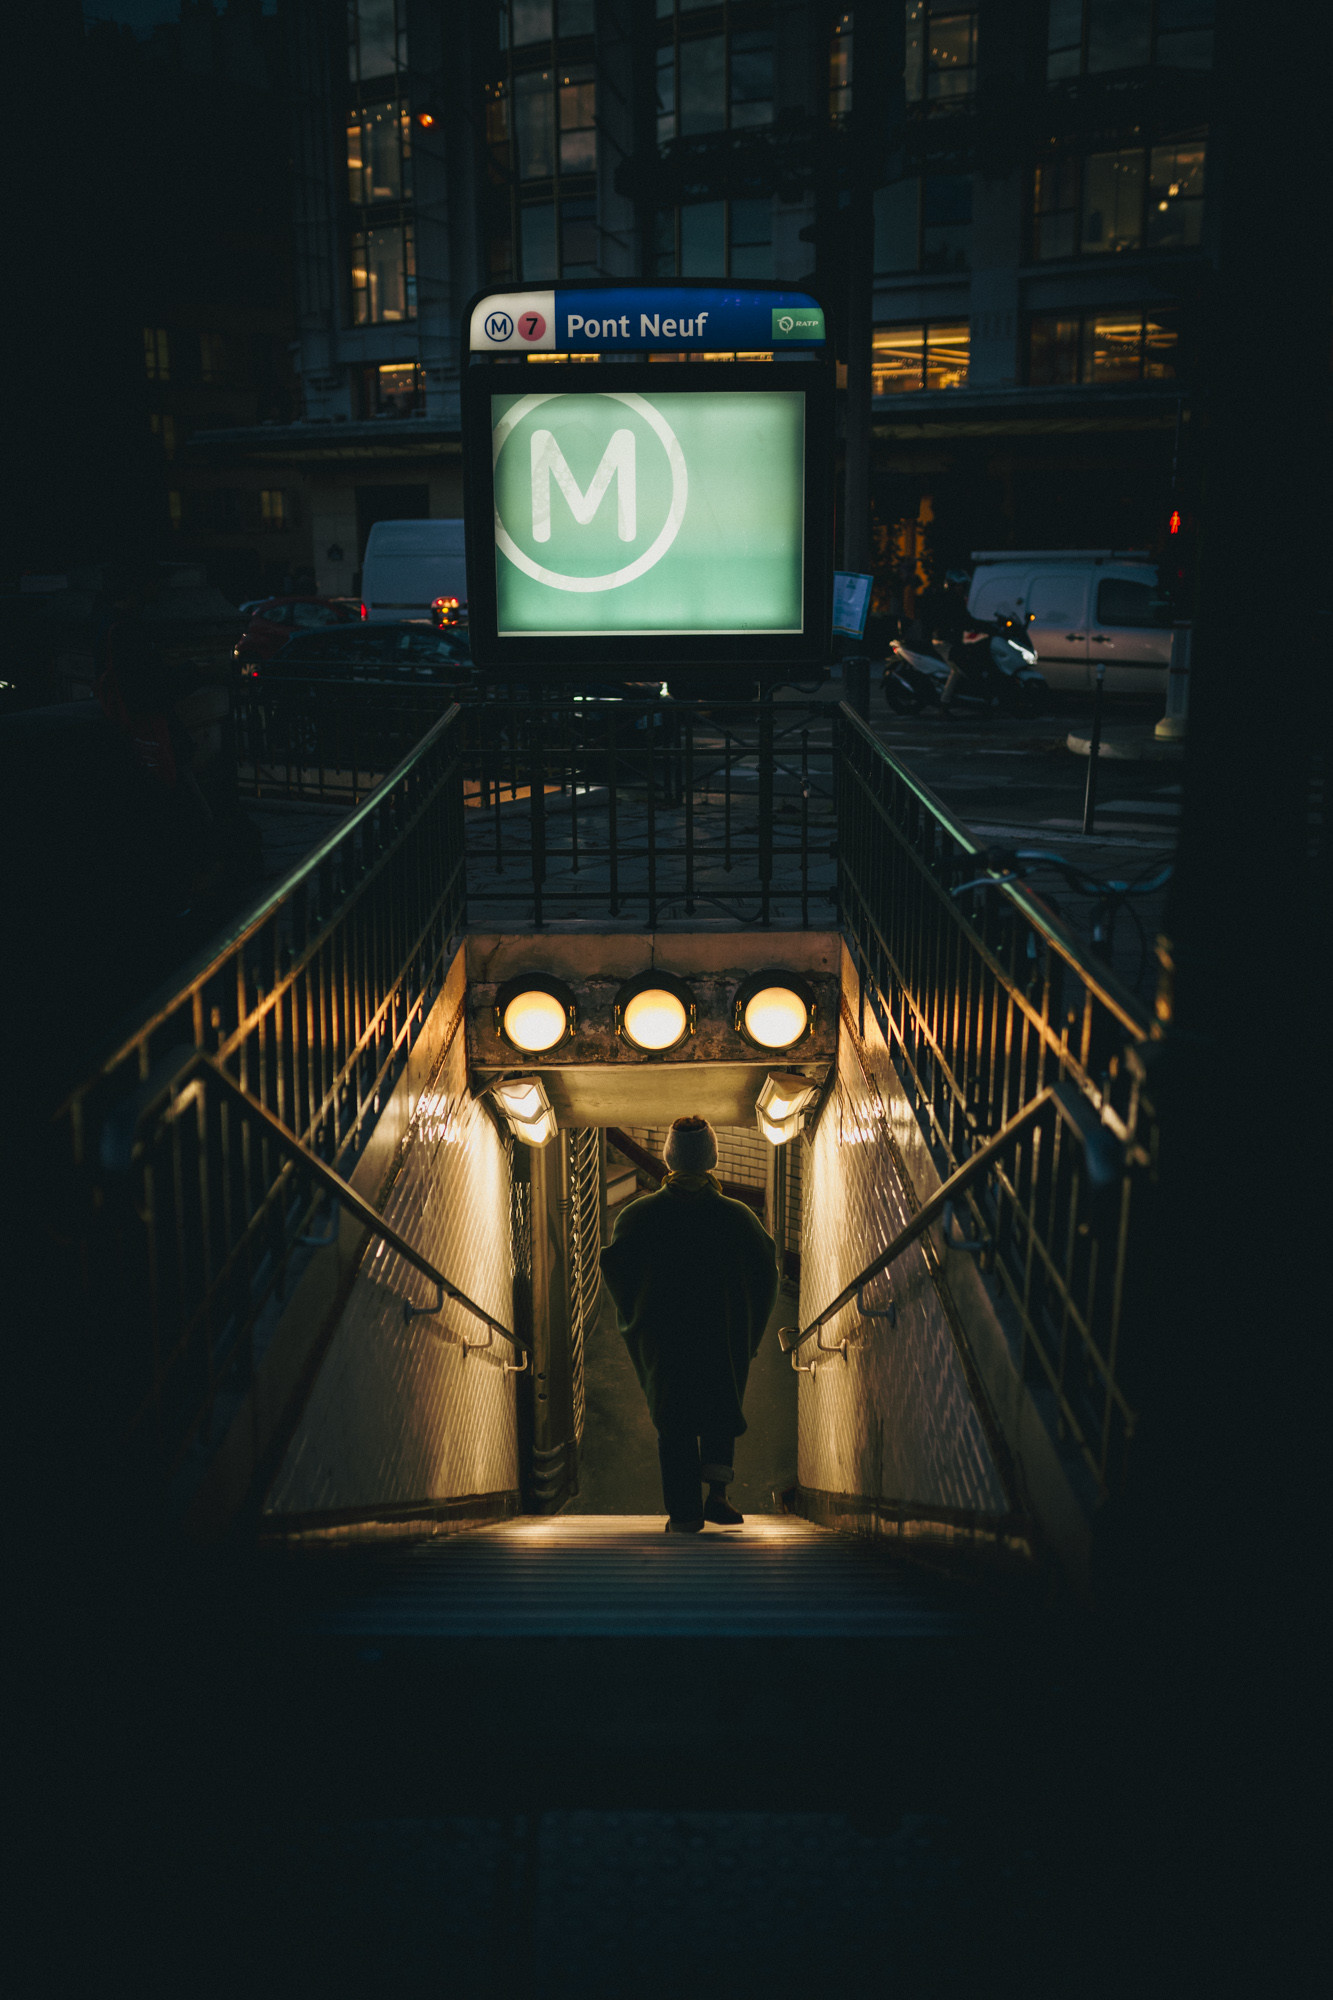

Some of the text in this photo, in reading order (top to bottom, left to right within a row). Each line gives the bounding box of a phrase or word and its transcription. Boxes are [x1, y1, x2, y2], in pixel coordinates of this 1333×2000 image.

[491, 318, 538, 335] M 7
[567, 312, 709, 338] Pont Neuf
[530, 428, 637, 543] M
